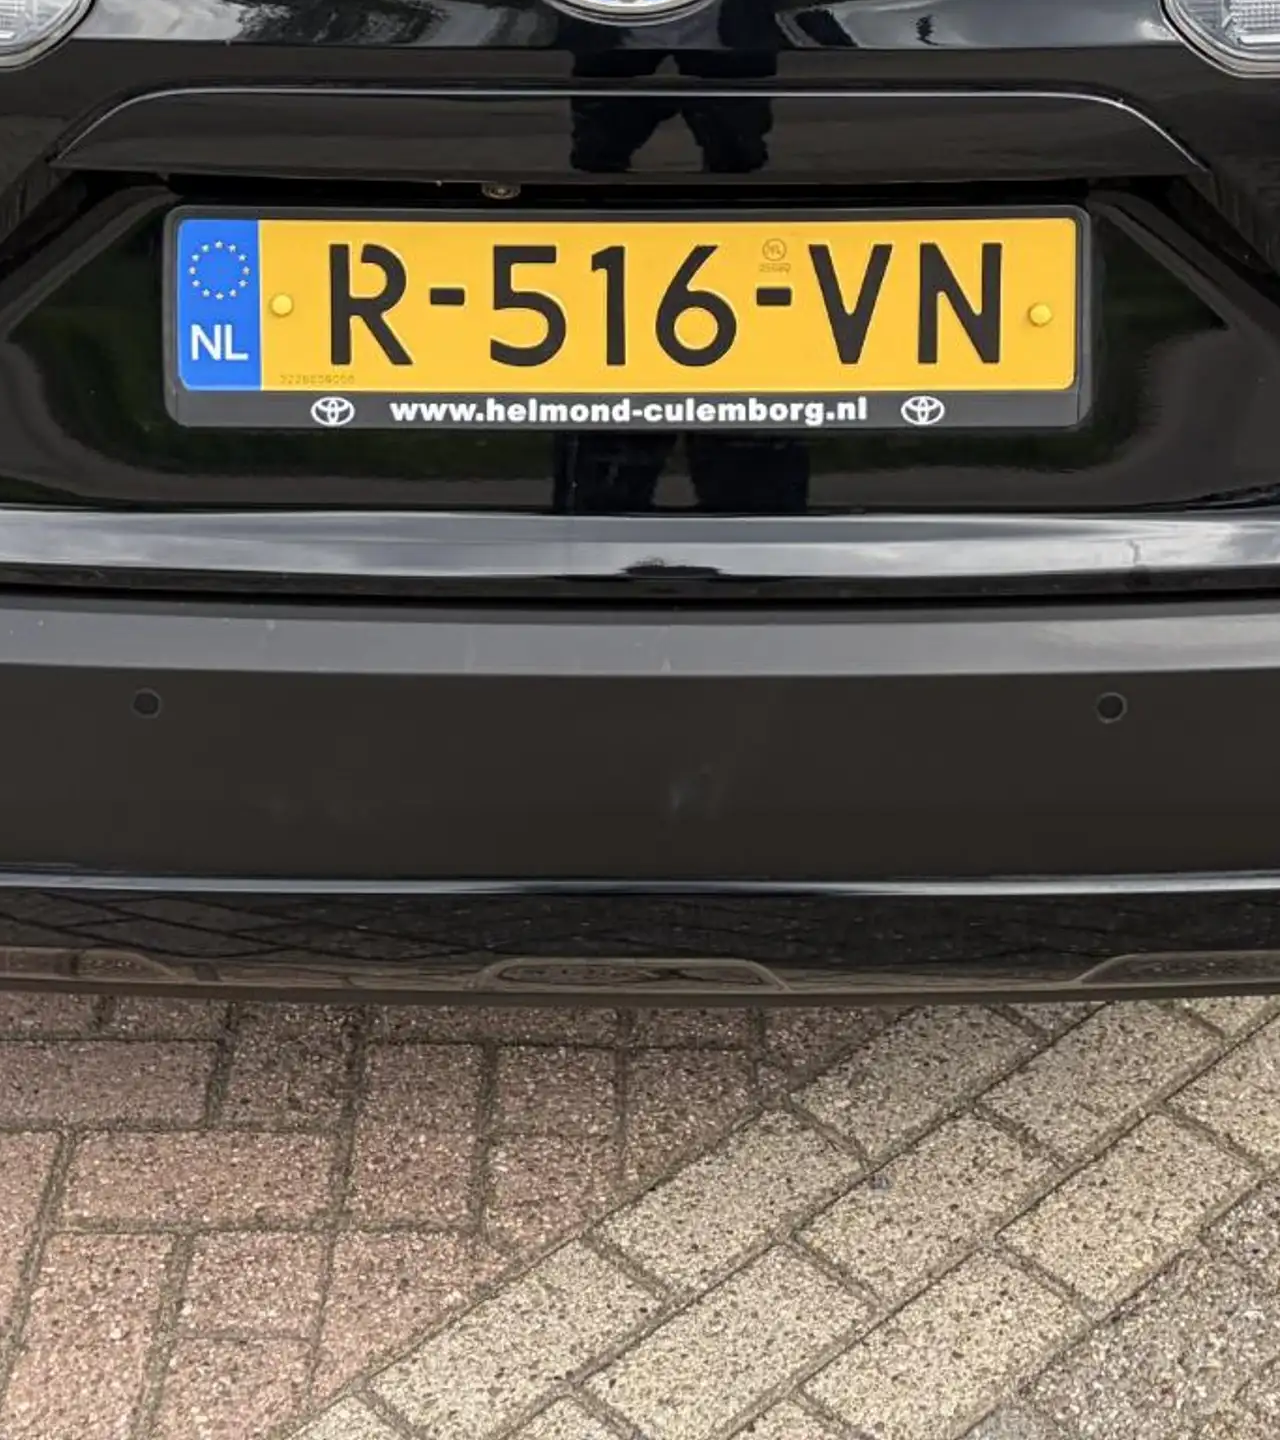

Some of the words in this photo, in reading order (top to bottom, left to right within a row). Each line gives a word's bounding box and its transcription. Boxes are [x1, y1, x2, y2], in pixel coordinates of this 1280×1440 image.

[328, 242, 1004, 367] R-516-VN
[190, 323, 249, 361] NL
[389, 396, 868, 426] www.helmond-culemborg.nl
